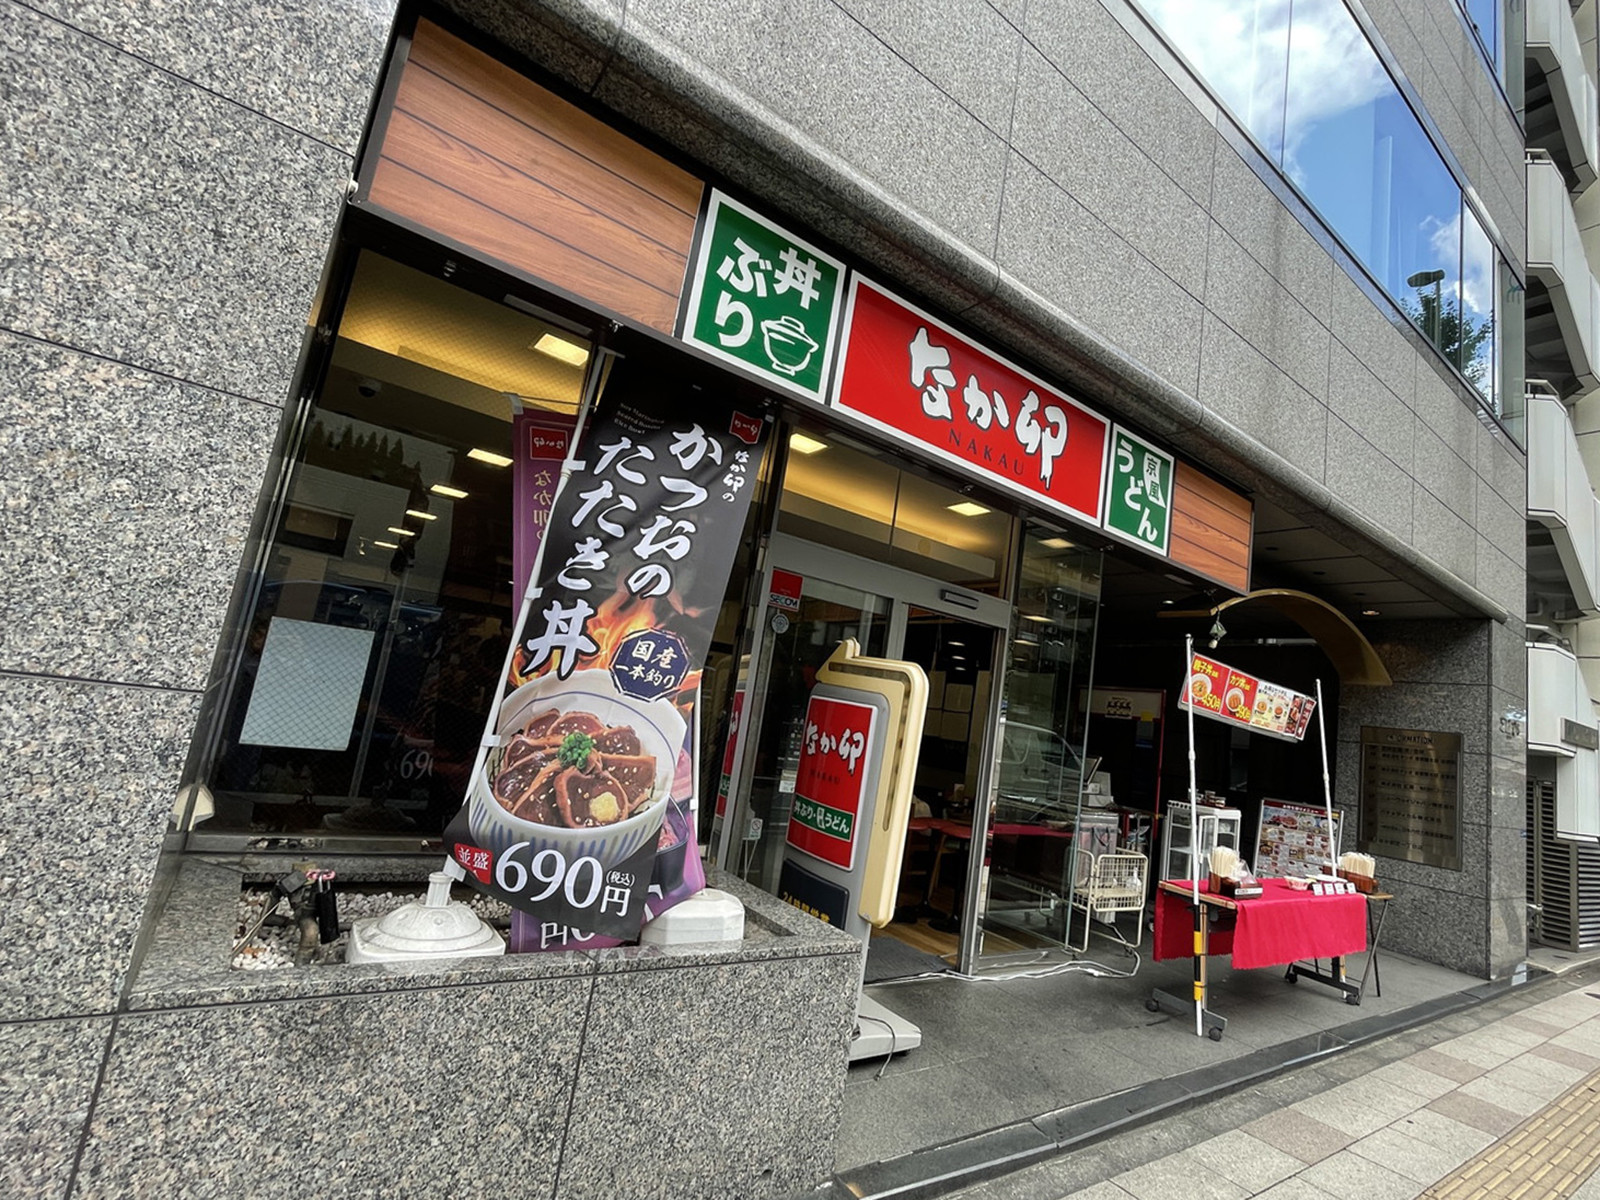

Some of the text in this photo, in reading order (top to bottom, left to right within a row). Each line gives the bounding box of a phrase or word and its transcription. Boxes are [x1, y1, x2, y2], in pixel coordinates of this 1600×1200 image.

[909, 325, 1069, 489] なか卯
[722, 450, 750, 502] なか卯の
[949, 428, 1024, 475] NAKAU
[625, 422, 724, 598] かつおの
[1116, 438, 1159, 543] うどん
[521, 436, 655, 677] たたき丼
[769, 593, 799, 608] SECOM
[615, 664, 676, 689] 一本釣り
[632, 640, 679, 669] 国産
[805, 719, 866, 777] なか卯
[458, 846, 490, 871] 並盛
[605, 870, 636, 888] (税込)
